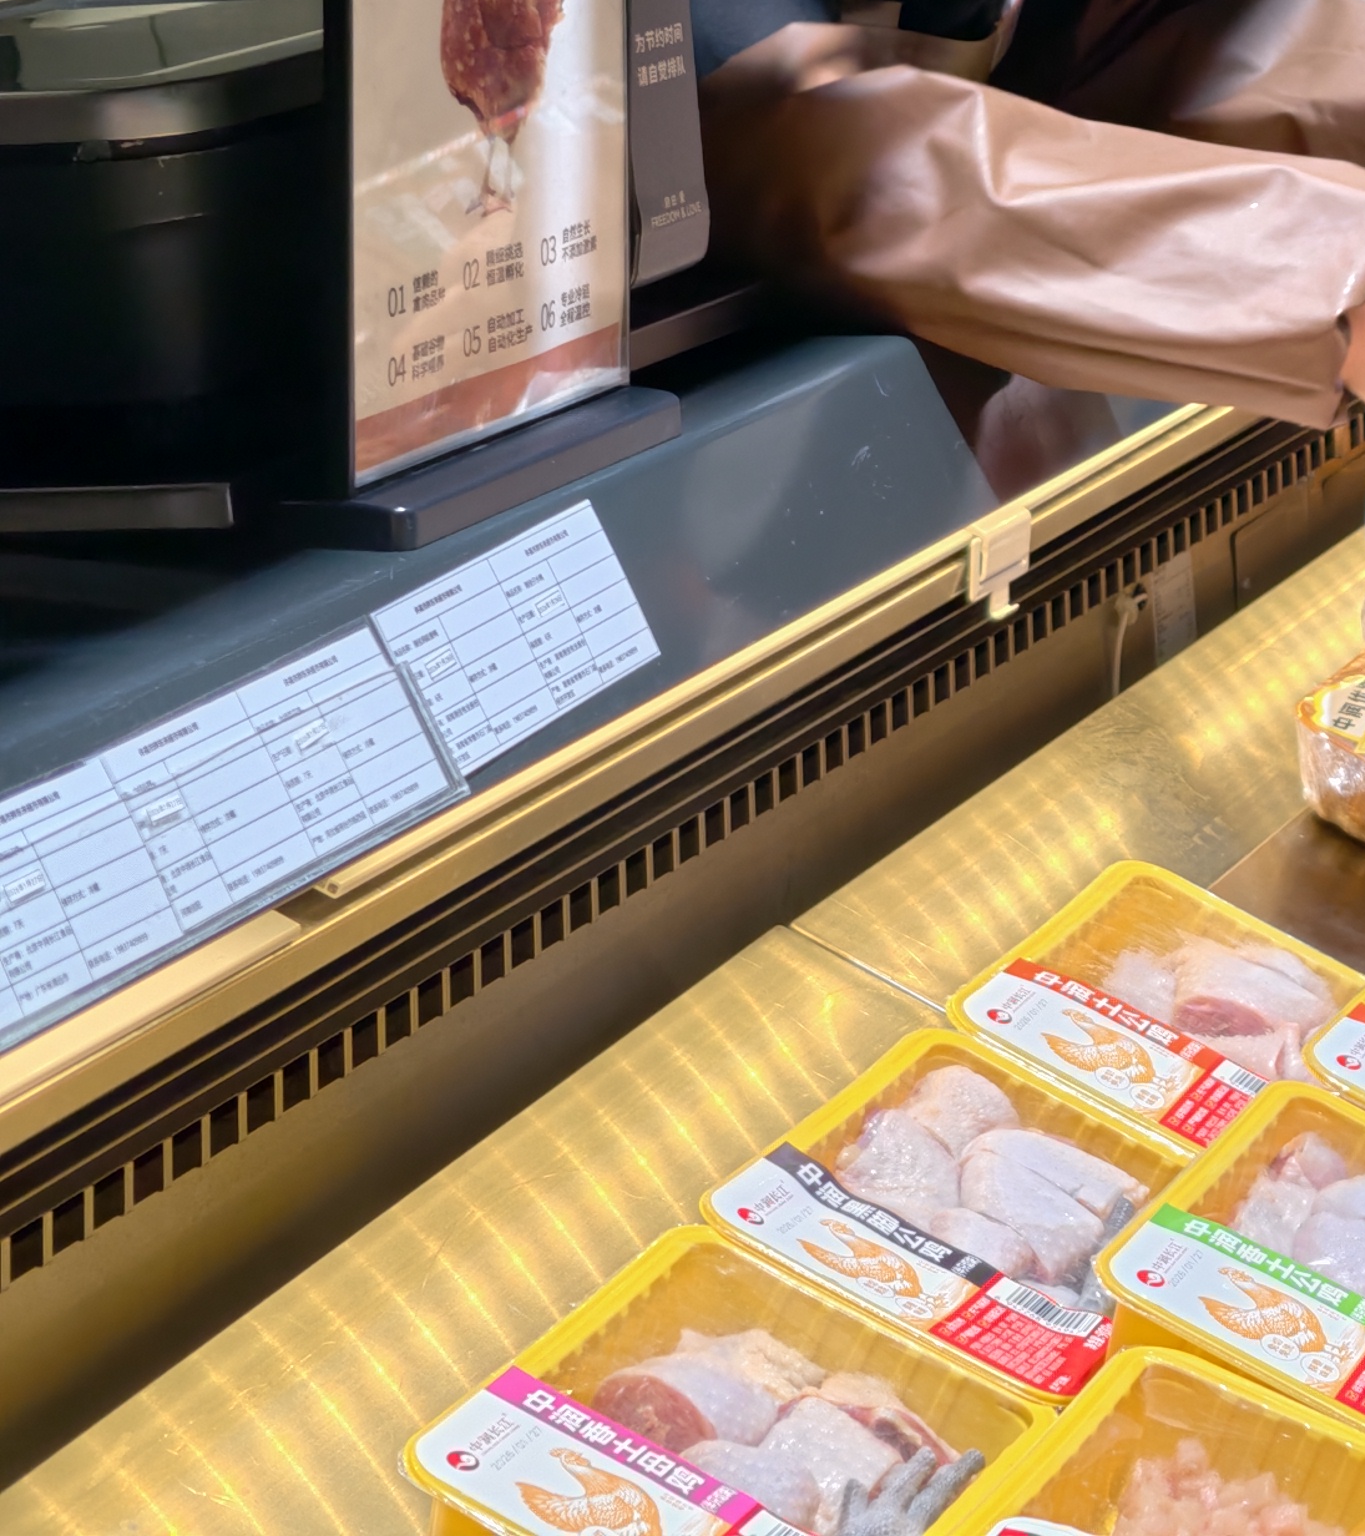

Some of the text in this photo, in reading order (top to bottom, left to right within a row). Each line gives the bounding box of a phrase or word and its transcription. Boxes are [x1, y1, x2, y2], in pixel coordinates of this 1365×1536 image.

[635, 21, 686, 54] 为节约时间
[637, 54, 688, 88] 请自觉排队
[539, 234, 559, 268] 03
[461, 258, 482, 292] 02
[387, 285, 408, 318] 01
[539, 299, 558, 333] 06
[461, 326, 483, 359] 05
[387, 356, 408, 388] 04
[753, 1180, 791, 1227] 中润长江
[1151, 1237, 1184, 1276] 中润长江
[1182, 1219, 1349, 1307] 中润香土公鸡
[468, 1412, 516, 1455] 中润长江
[521, 1386, 707, 1498] 中润香土母鸡
